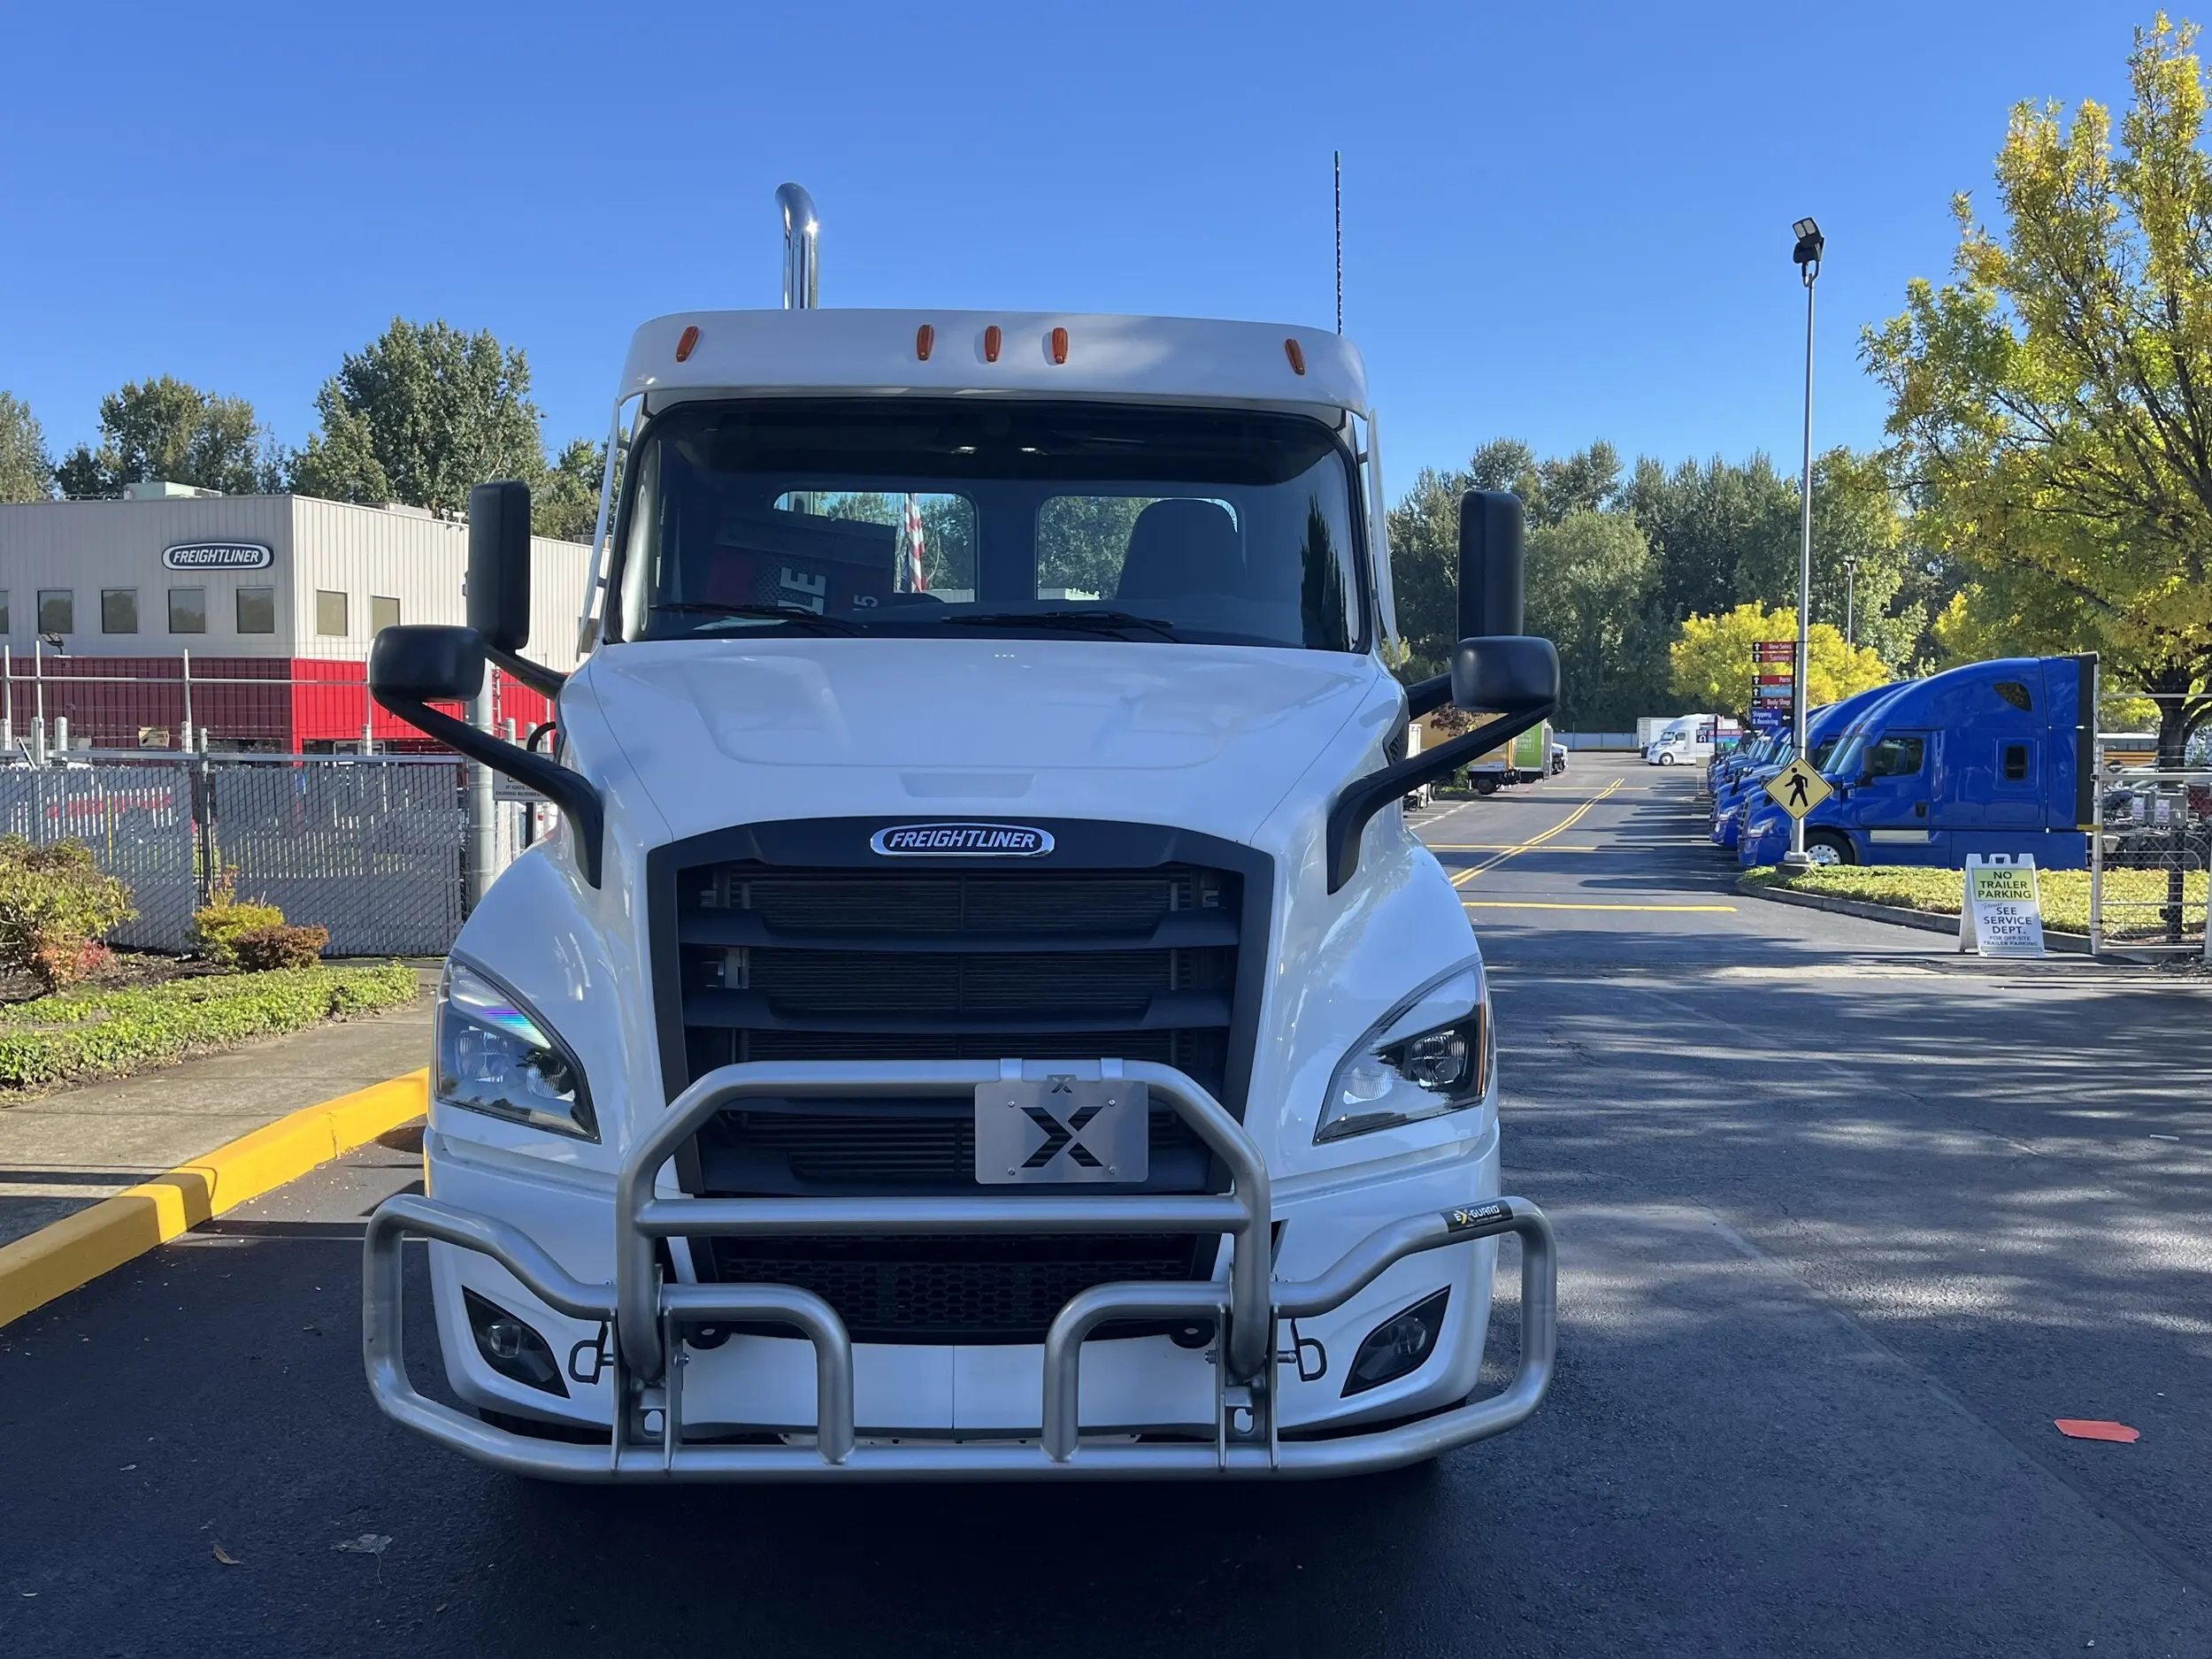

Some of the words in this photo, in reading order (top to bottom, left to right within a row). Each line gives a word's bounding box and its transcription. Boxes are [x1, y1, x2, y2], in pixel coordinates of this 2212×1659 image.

[173, 549, 259, 564] FREIGHTLINER
[888, 829, 1036, 849] FREIGHTLINER
[1993, 871, 2012, 879] NO
[1979, 880, 2027, 889] TRAILER
[1978, 890, 2032, 899] PARKING
[1996, 907, 2017, 916] SEE
[1983, 917, 2032, 926] SERVICE
[1992, 926, 2026, 934] DEPT.
